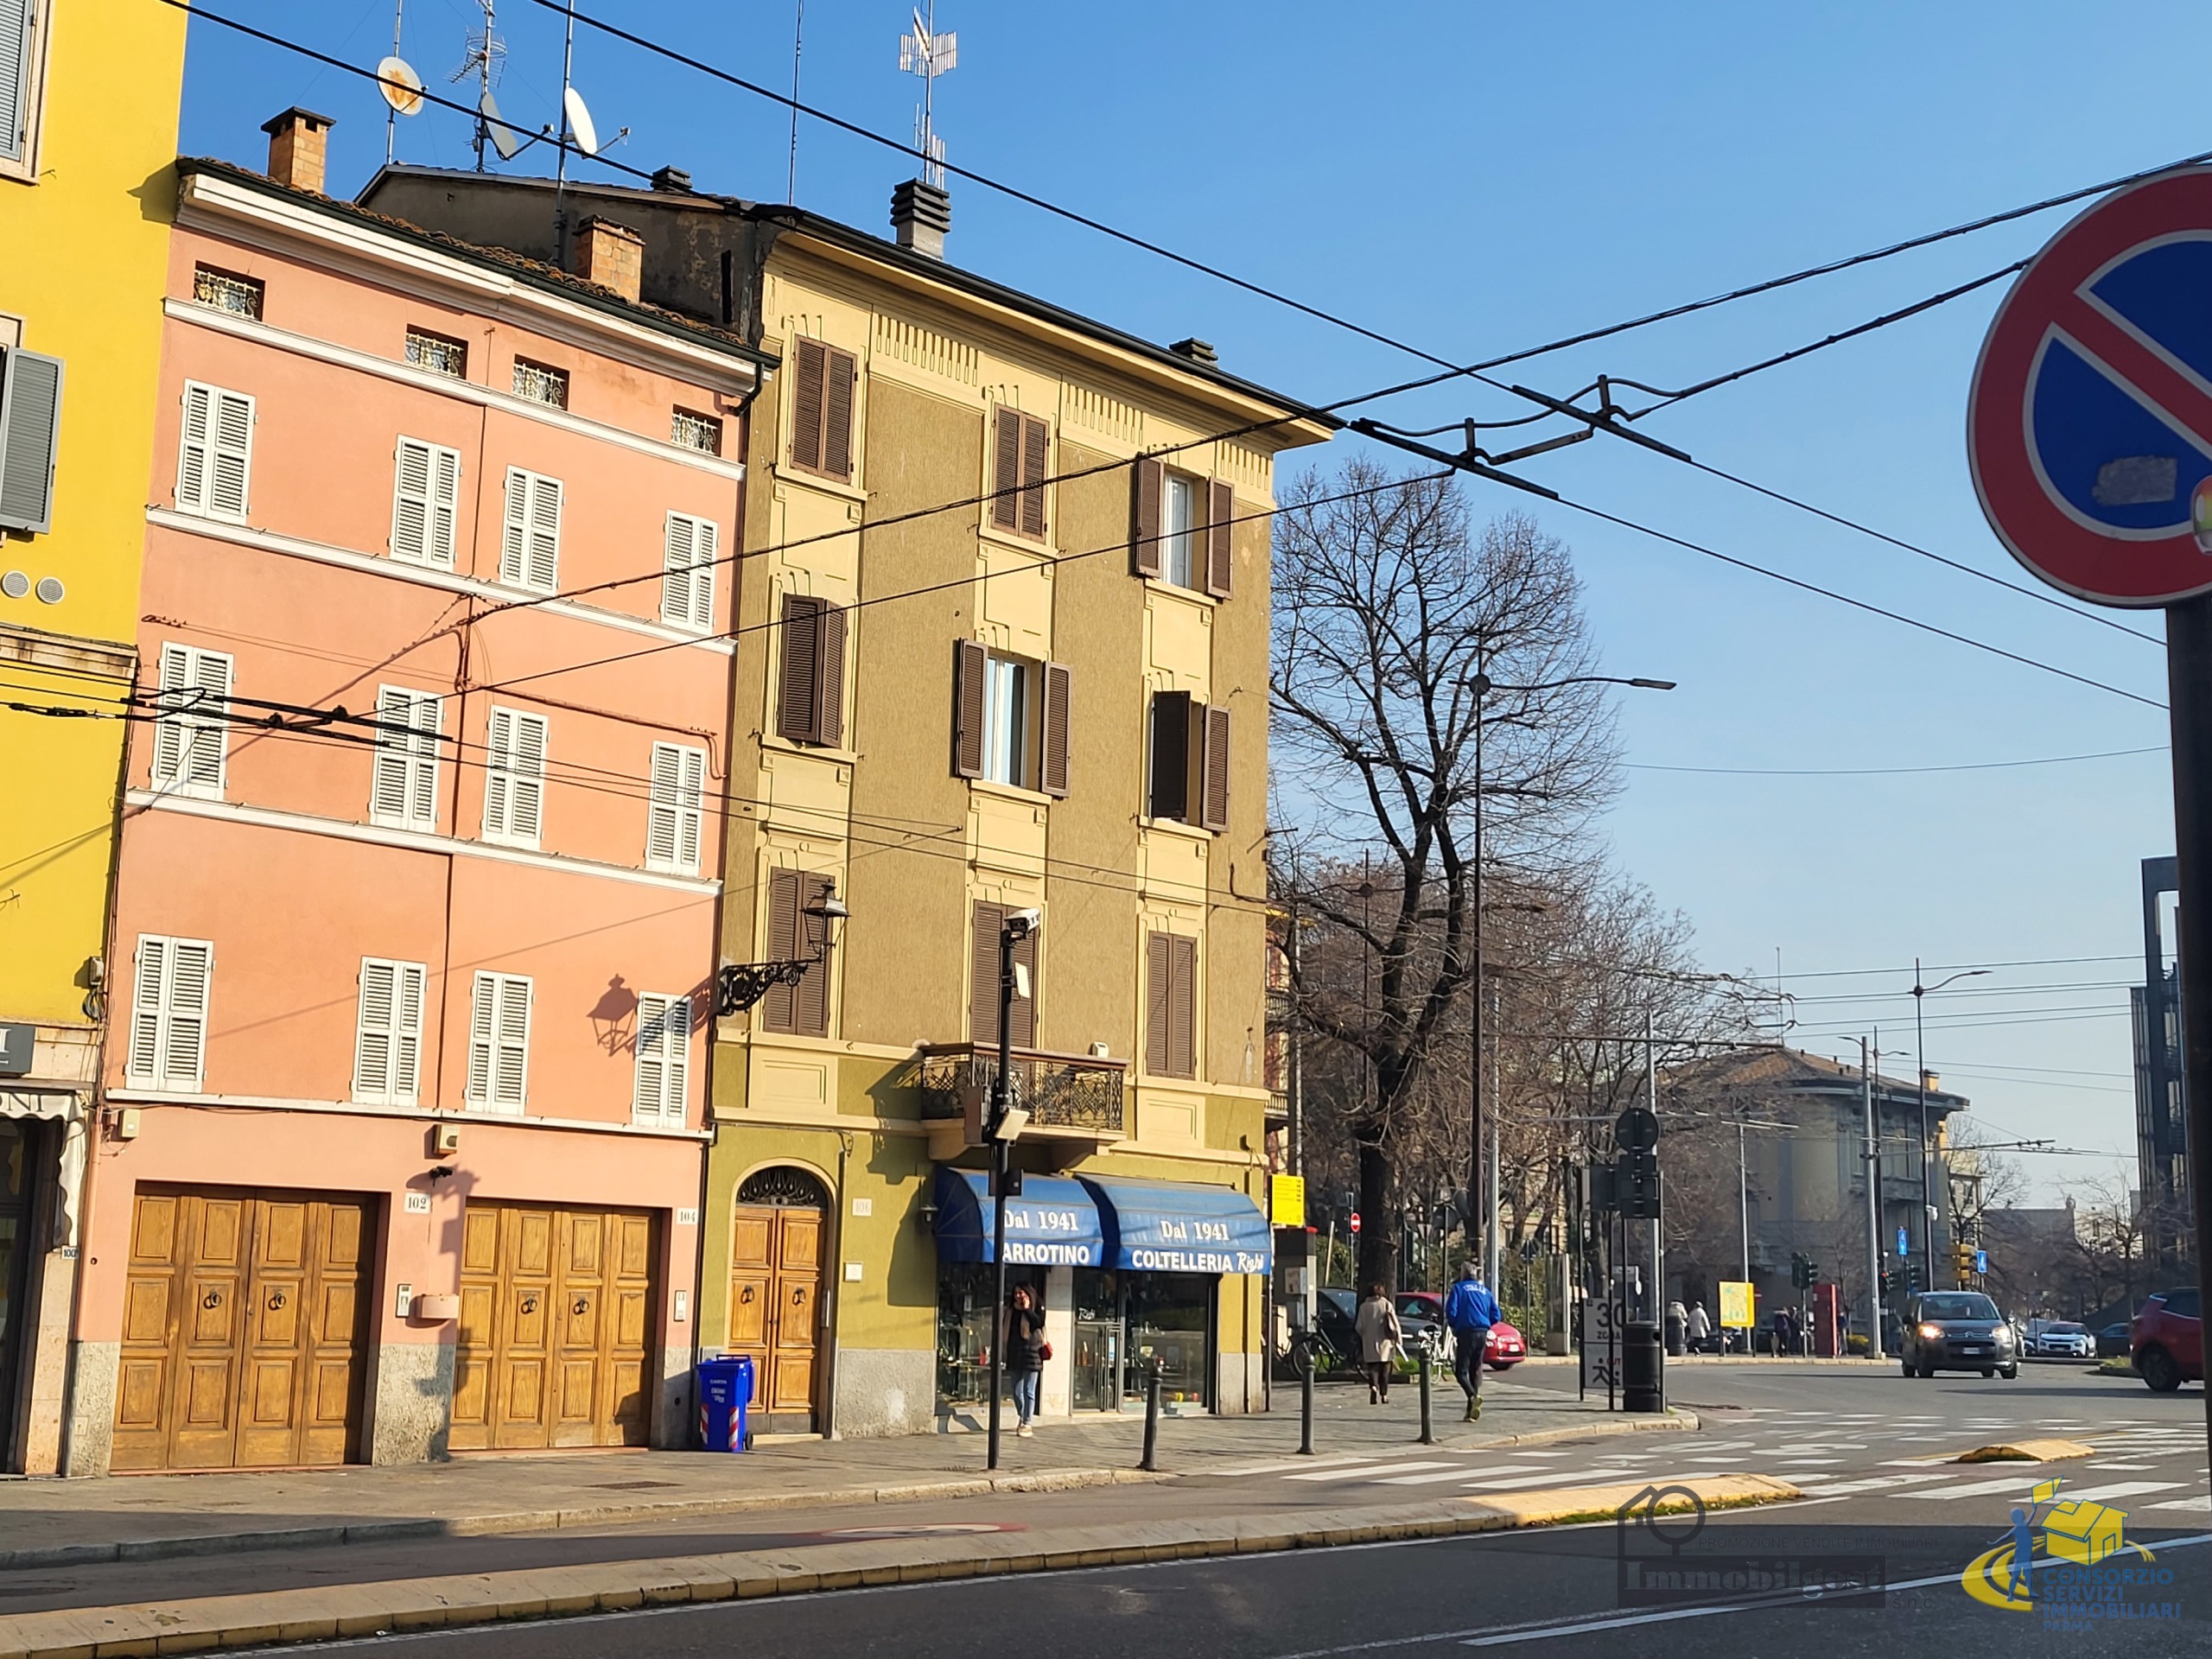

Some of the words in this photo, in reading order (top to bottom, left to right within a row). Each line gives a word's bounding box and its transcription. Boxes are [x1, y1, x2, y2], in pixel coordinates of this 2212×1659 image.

[0, 1093, 44, 1113] NI
[408, 1197, 427, 1210] 102
[680, 1211, 695, 1223] 104
[1004, 1210, 1029, 1228] Dal
[1039, 1211, 1078, 1231] 1941
[1160, 1220, 1187, 1239] Dal
[1193, 1222, 1230, 1241] 1941
[1002, 1243, 1090, 1264] ARROTINO
[1132, 1249, 1233, 1272] COLTELLERIA
[1236, 1251, 1264, 1272] Righi
